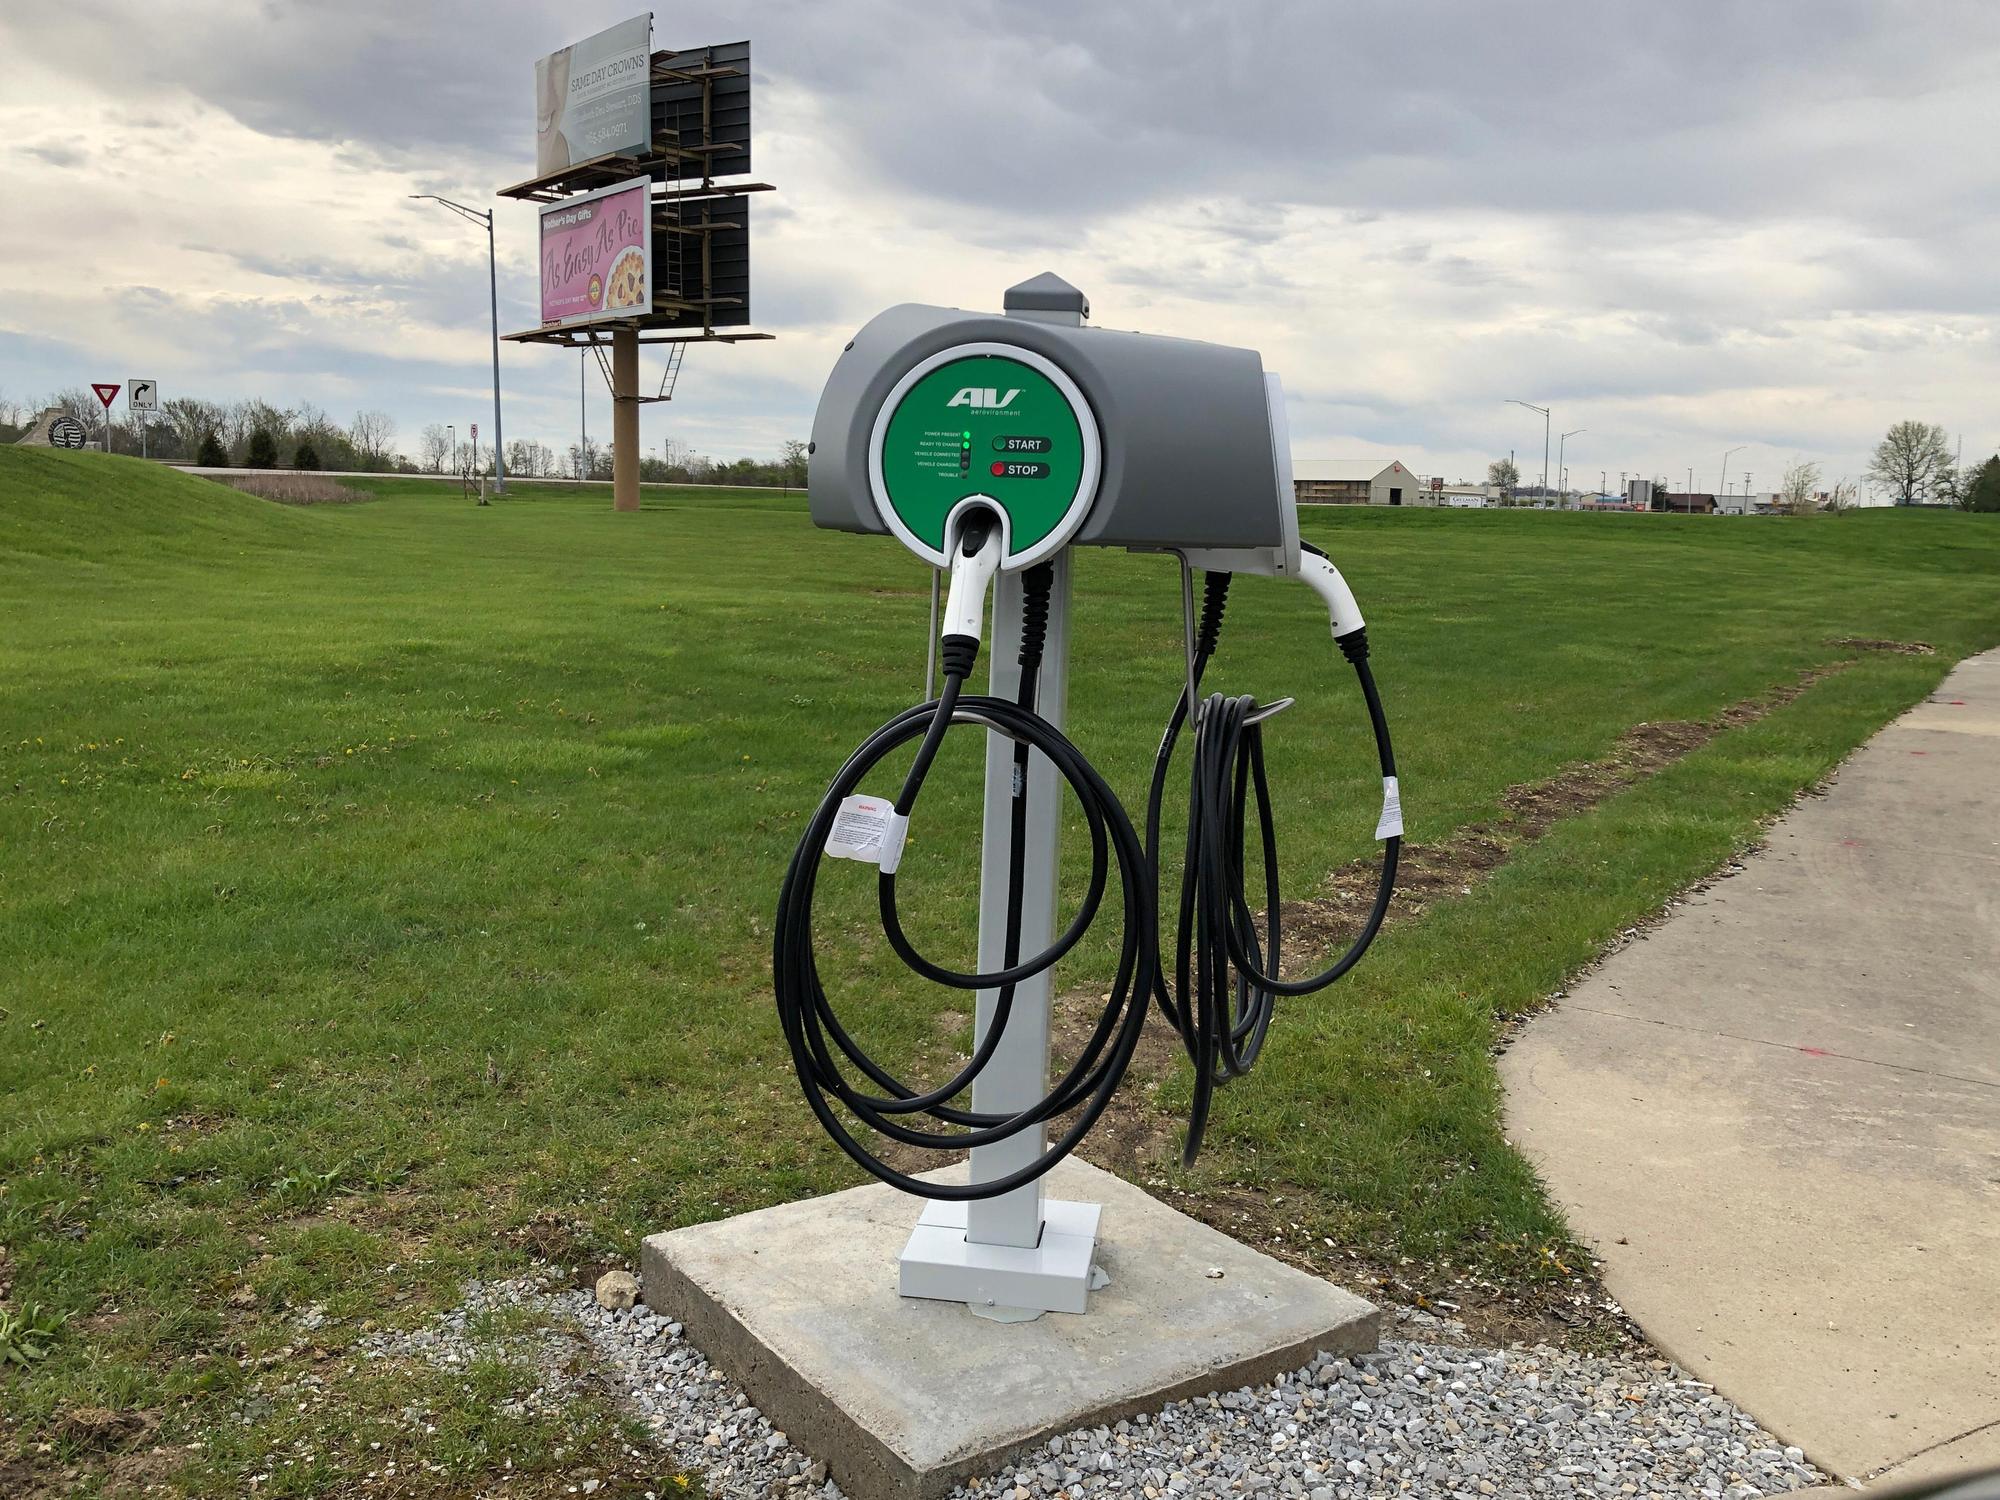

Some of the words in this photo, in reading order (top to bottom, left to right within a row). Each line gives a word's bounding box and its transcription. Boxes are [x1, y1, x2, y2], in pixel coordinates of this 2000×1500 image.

[571, 73, 591, 93] SAME
[592, 65, 607, 85] DAY
[607, 54, 645, 78] CROWNS
[565, 213, 577, 225] Day
[577, 208, 592, 220] Gifts
[545, 247, 561, 294] As
[563, 236, 594, 284] Easy
[595, 218, 614, 263] As
[945, 387, 1021, 408] AV
[970, 409, 1021, 417] aerovironment
[1008, 439, 1042, 450] START
[1008, 464, 1039, 475] STOP
